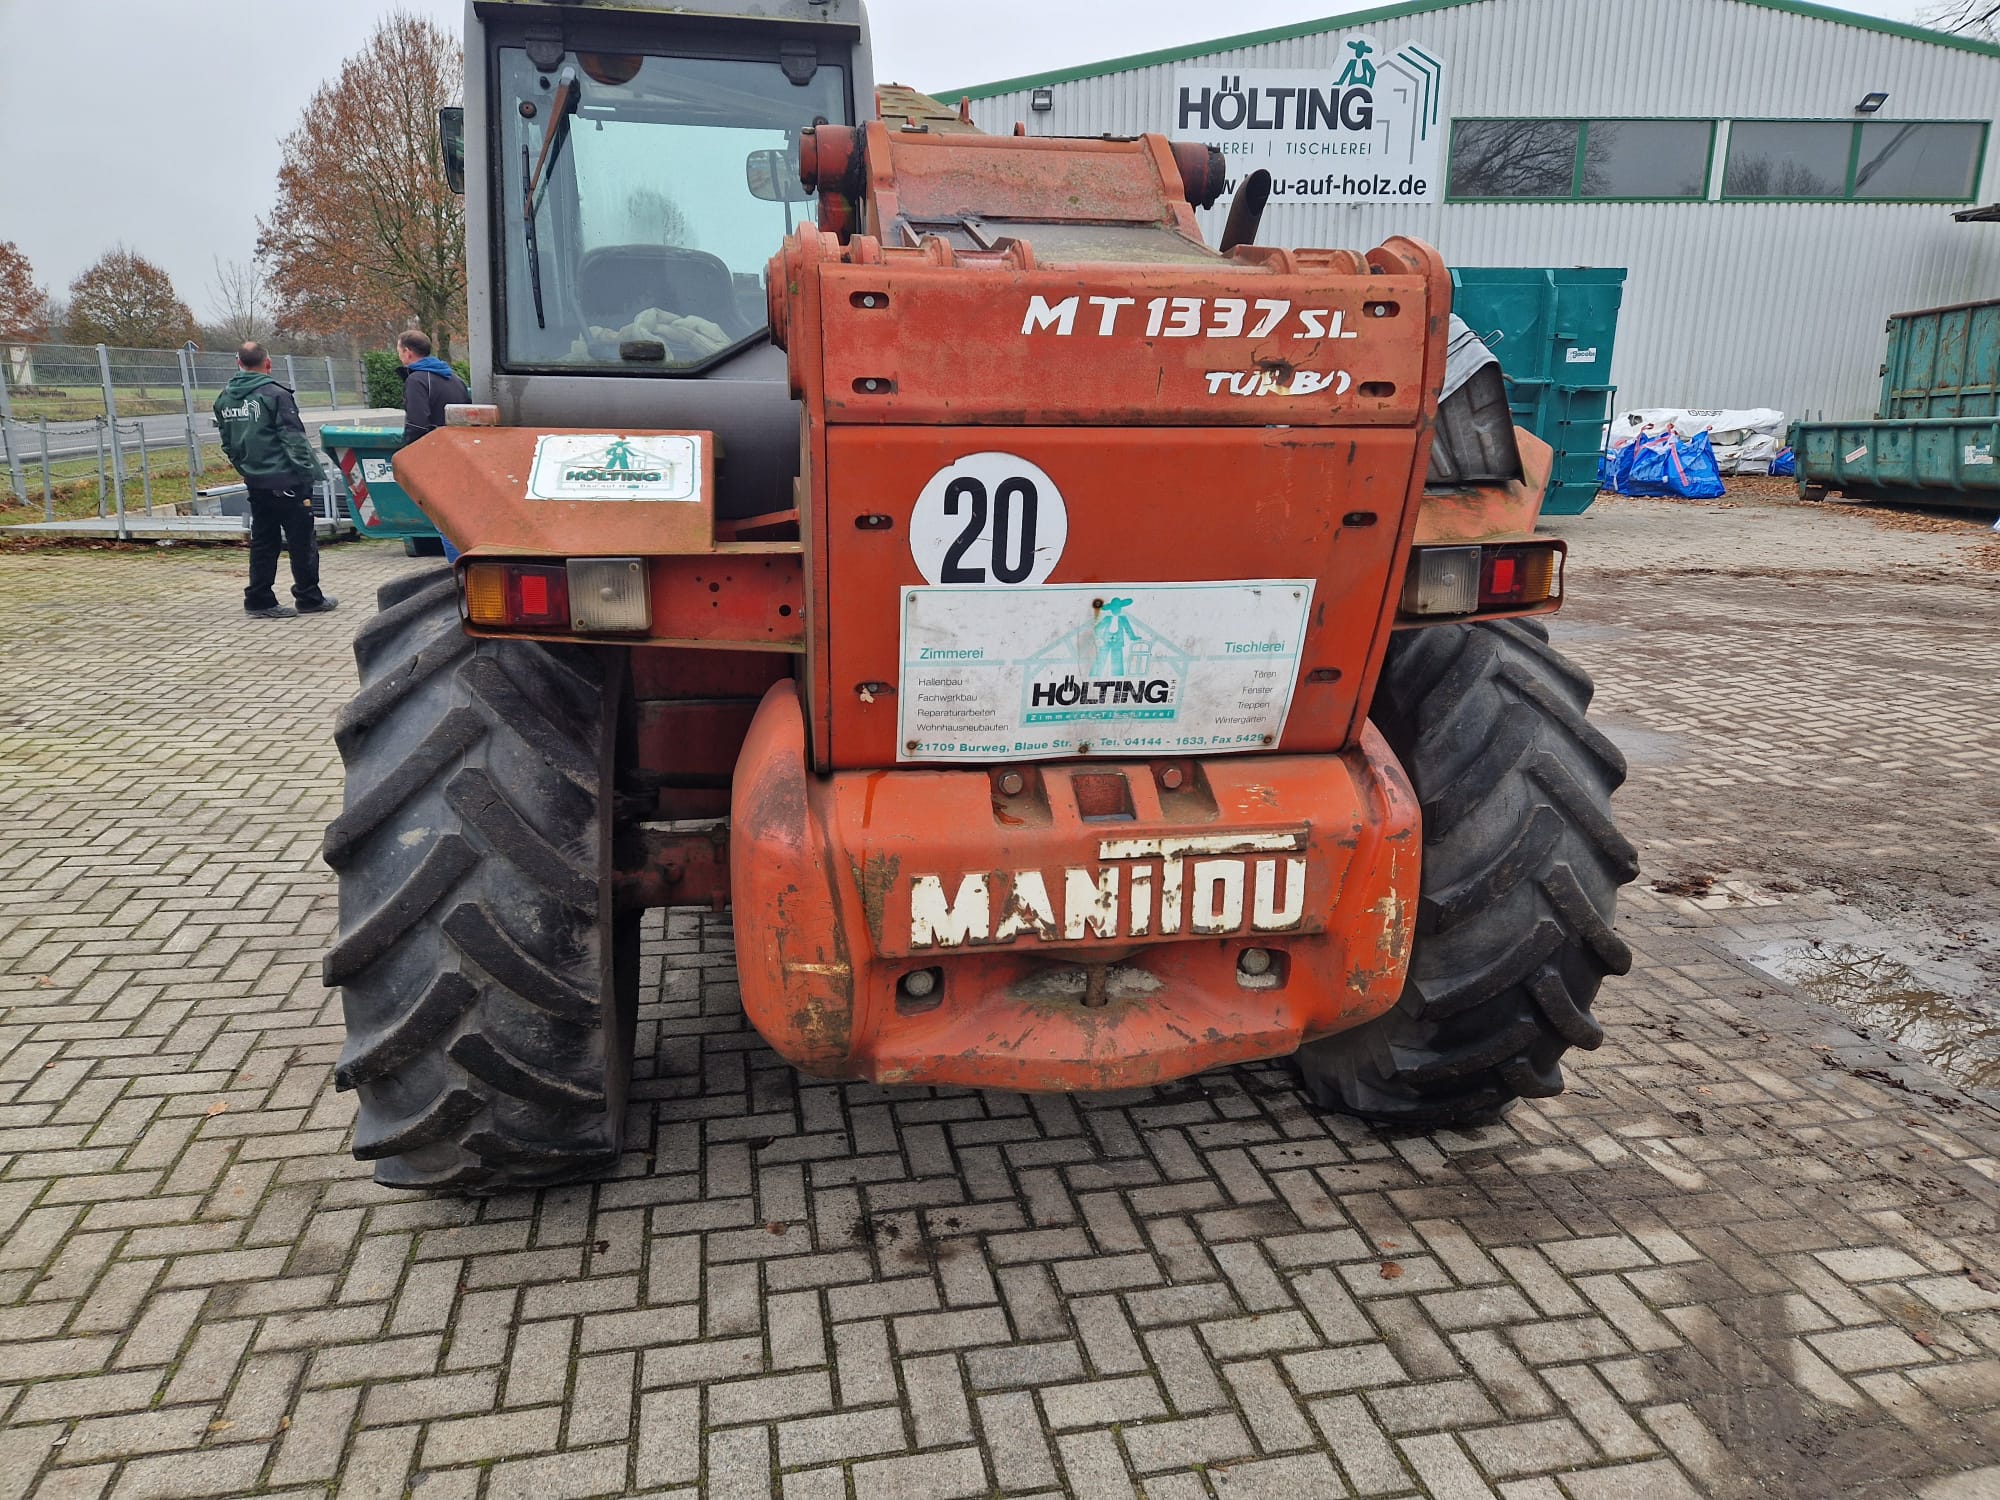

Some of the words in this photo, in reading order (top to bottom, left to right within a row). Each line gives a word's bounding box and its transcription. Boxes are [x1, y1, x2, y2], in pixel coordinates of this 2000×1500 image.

[1178, 75, 1374, 131] HÖLTING
[1285, 142, 1372, 155] TISCHLEREI
[1145, 297, 1291, 338] 1337
[1292, 309, 1358, 338] SL
[565, 469, 662, 482] HÖLTING
[940, 476, 1039, 584] 20
[919, 647, 984, 660] Zimmerei
[1224, 640, 1286, 654] Tischlerei
[918, 678, 963, 687] Hallenbau
[1031, 675, 1170, 707] HÖLTING
[1242, 686, 1273, 695] Fenster
[917, 693, 978, 703] Fachwerkbau
[1237, 701, 1270, 710] Treppen
[916, 709, 996, 719] Reparaturarbeiten
[1214, 715, 1267, 725] Wintergärten
[916, 723, 1009, 733] Wohnhausneubauten
[916, 743, 955, 752] 21709
[959, 743, 1010, 753] Burweg,
[1014, 741, 1048, 751] Blaue
[1052, 739, 1072, 748] Str.
[1124, 737, 1162, 746] 04144
[1211, 735, 1231, 744] Fax
[910, 832, 1309, 949] MANITOU
